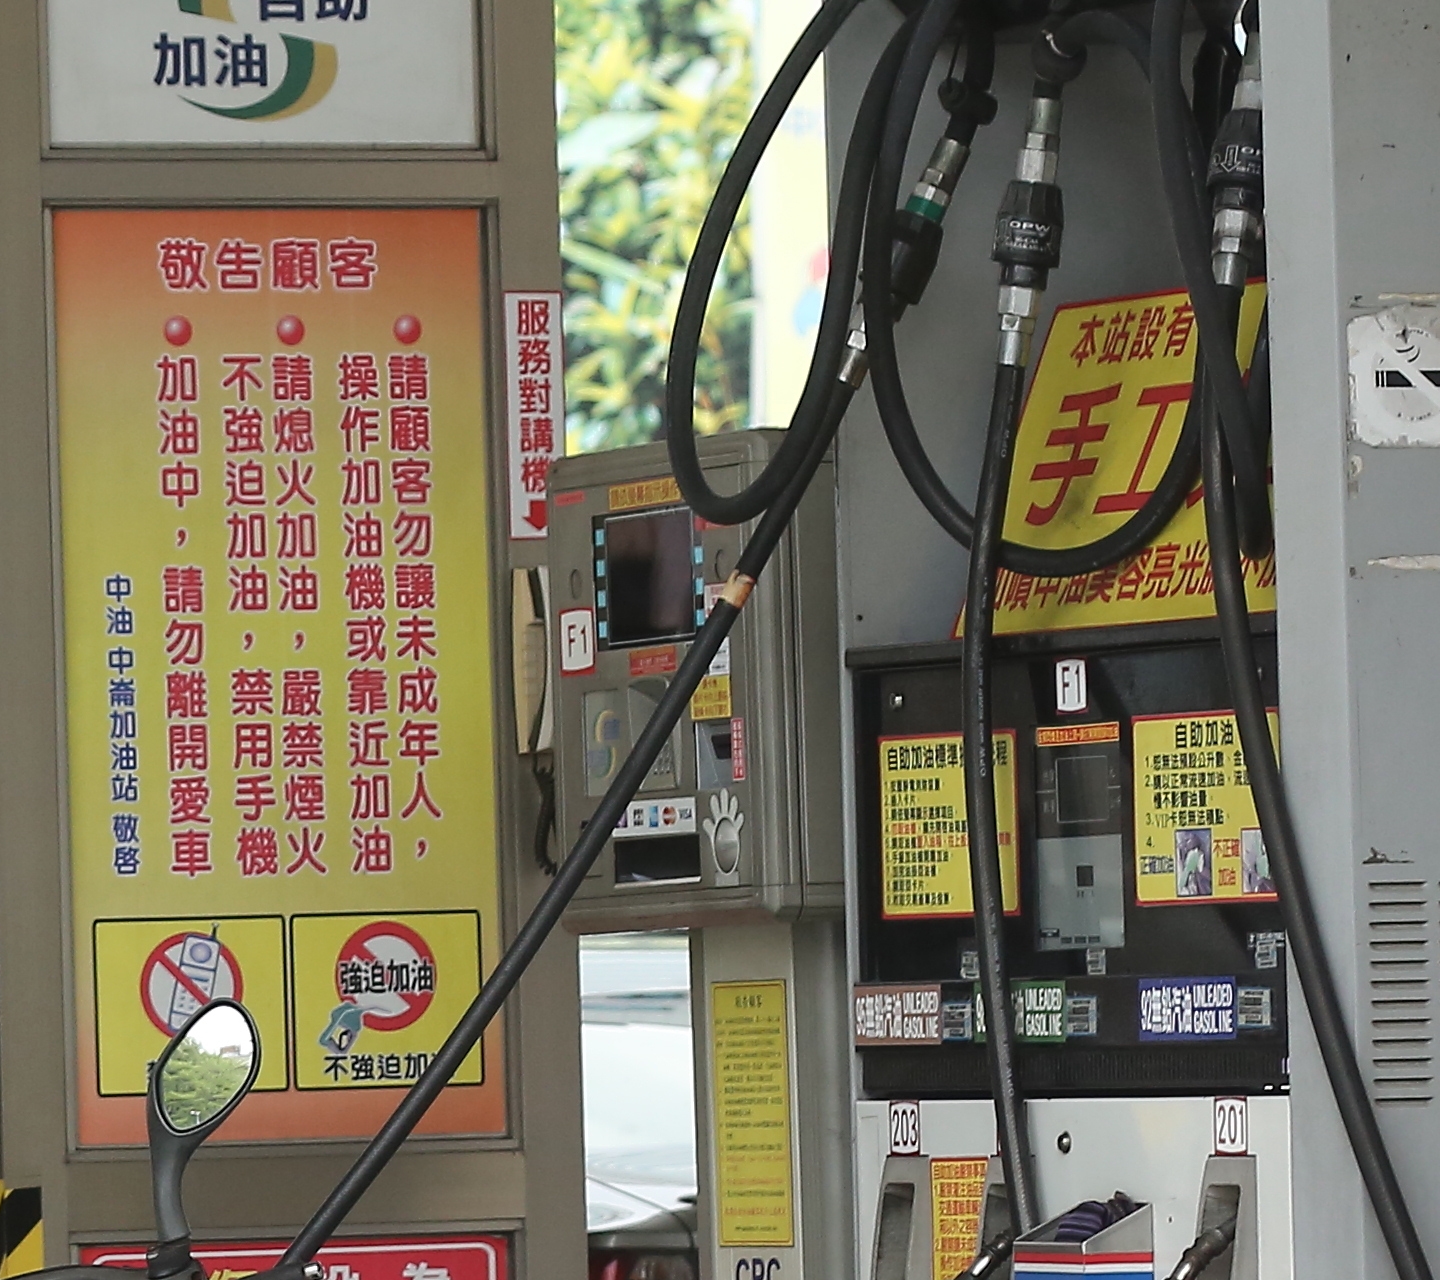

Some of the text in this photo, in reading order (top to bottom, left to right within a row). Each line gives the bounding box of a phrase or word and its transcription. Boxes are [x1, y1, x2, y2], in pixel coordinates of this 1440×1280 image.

[153, 32, 269, 88] 加油
[1009, 220, 1050, 232] OPW
[157, 237, 378, 292] 敬告顧客
[1070, 299, 1195, 368] 本站設有
[516, 299, 551, 495] 服務對講機
[105, 573, 134, 637] 中油
[338, 354, 393, 875] 操作加油機或靠近加油
[567, 622, 587, 658] F1
[1062, 665, 1082, 705] F1
[887, 740, 1008, 772] 自助加油標準程
[339, 959, 434, 995] 強迫加油
[903, 990, 938, 1015] UNLEADED
[1024, 985, 1062, 1012] UNLEADED
[1192, 983, 1233, 1009] UNLEADED
[903, 1015, 939, 1040] GASOLINE
[1024, 1013, 1062, 1038] GASOLINE
[1192, 1009, 1234, 1035] GASOLINE
[892, 1108, 918, 1147] 203
[1217, 1107, 1245, 1147] 201
